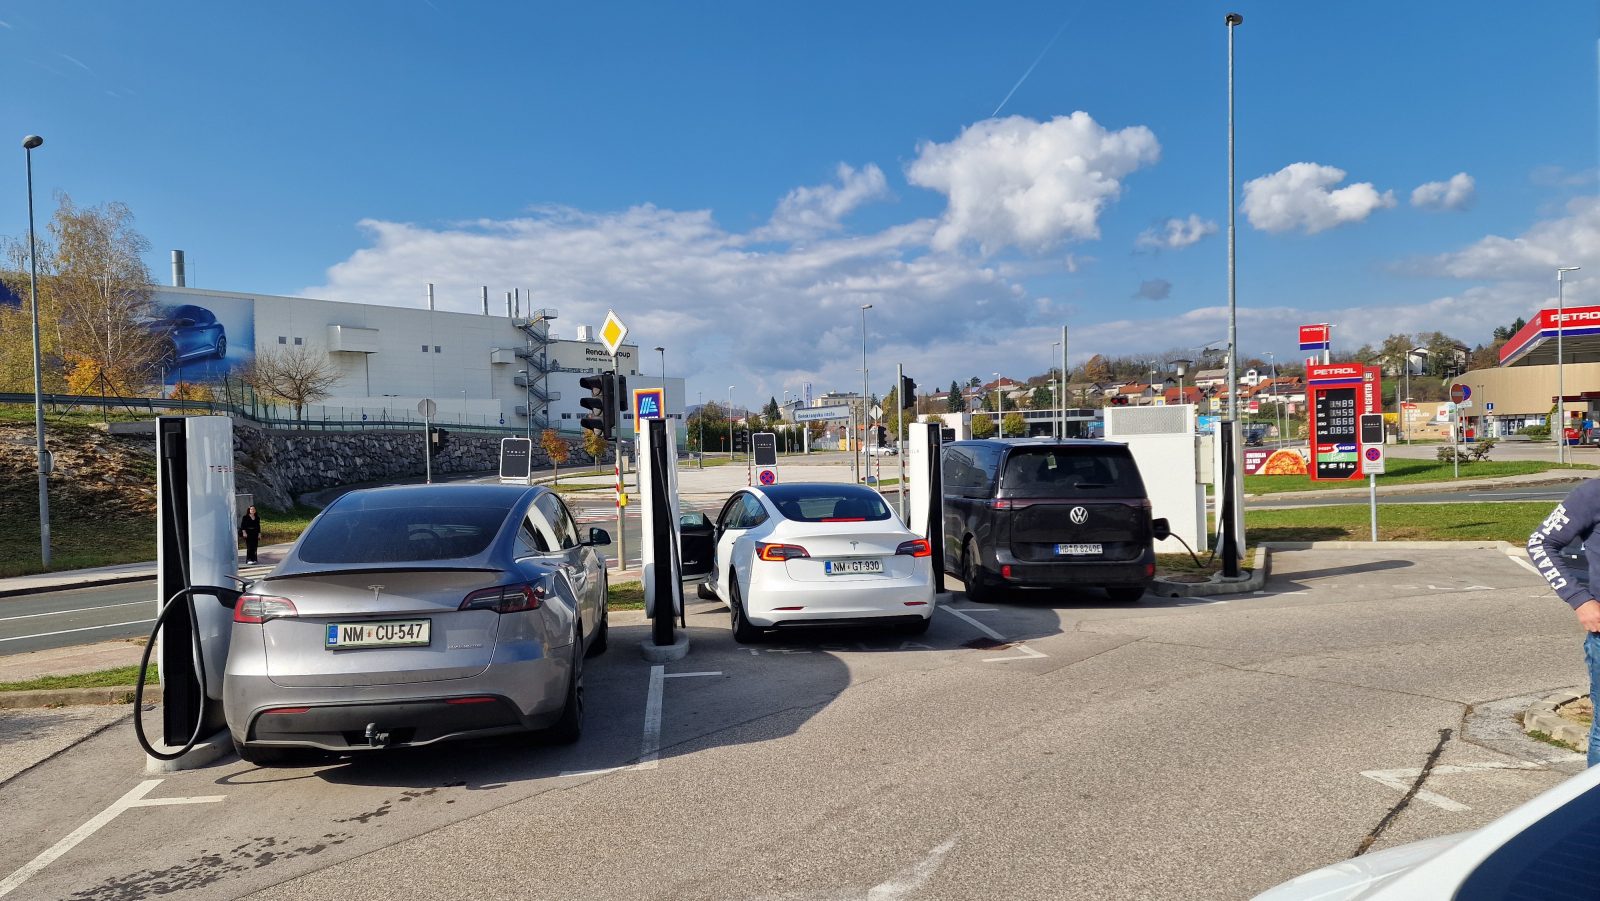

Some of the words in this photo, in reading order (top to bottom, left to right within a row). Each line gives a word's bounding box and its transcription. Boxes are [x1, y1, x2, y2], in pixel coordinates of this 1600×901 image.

[1550, 311, 1600, 322] PETRO
[1313, 367, 1356, 375] PETROL
[833, 562, 846, 572] NM
[852, 560, 880, 571] GT-930
[343, 626, 364, 642] NM
[375, 624, 423, 641] CU-547
